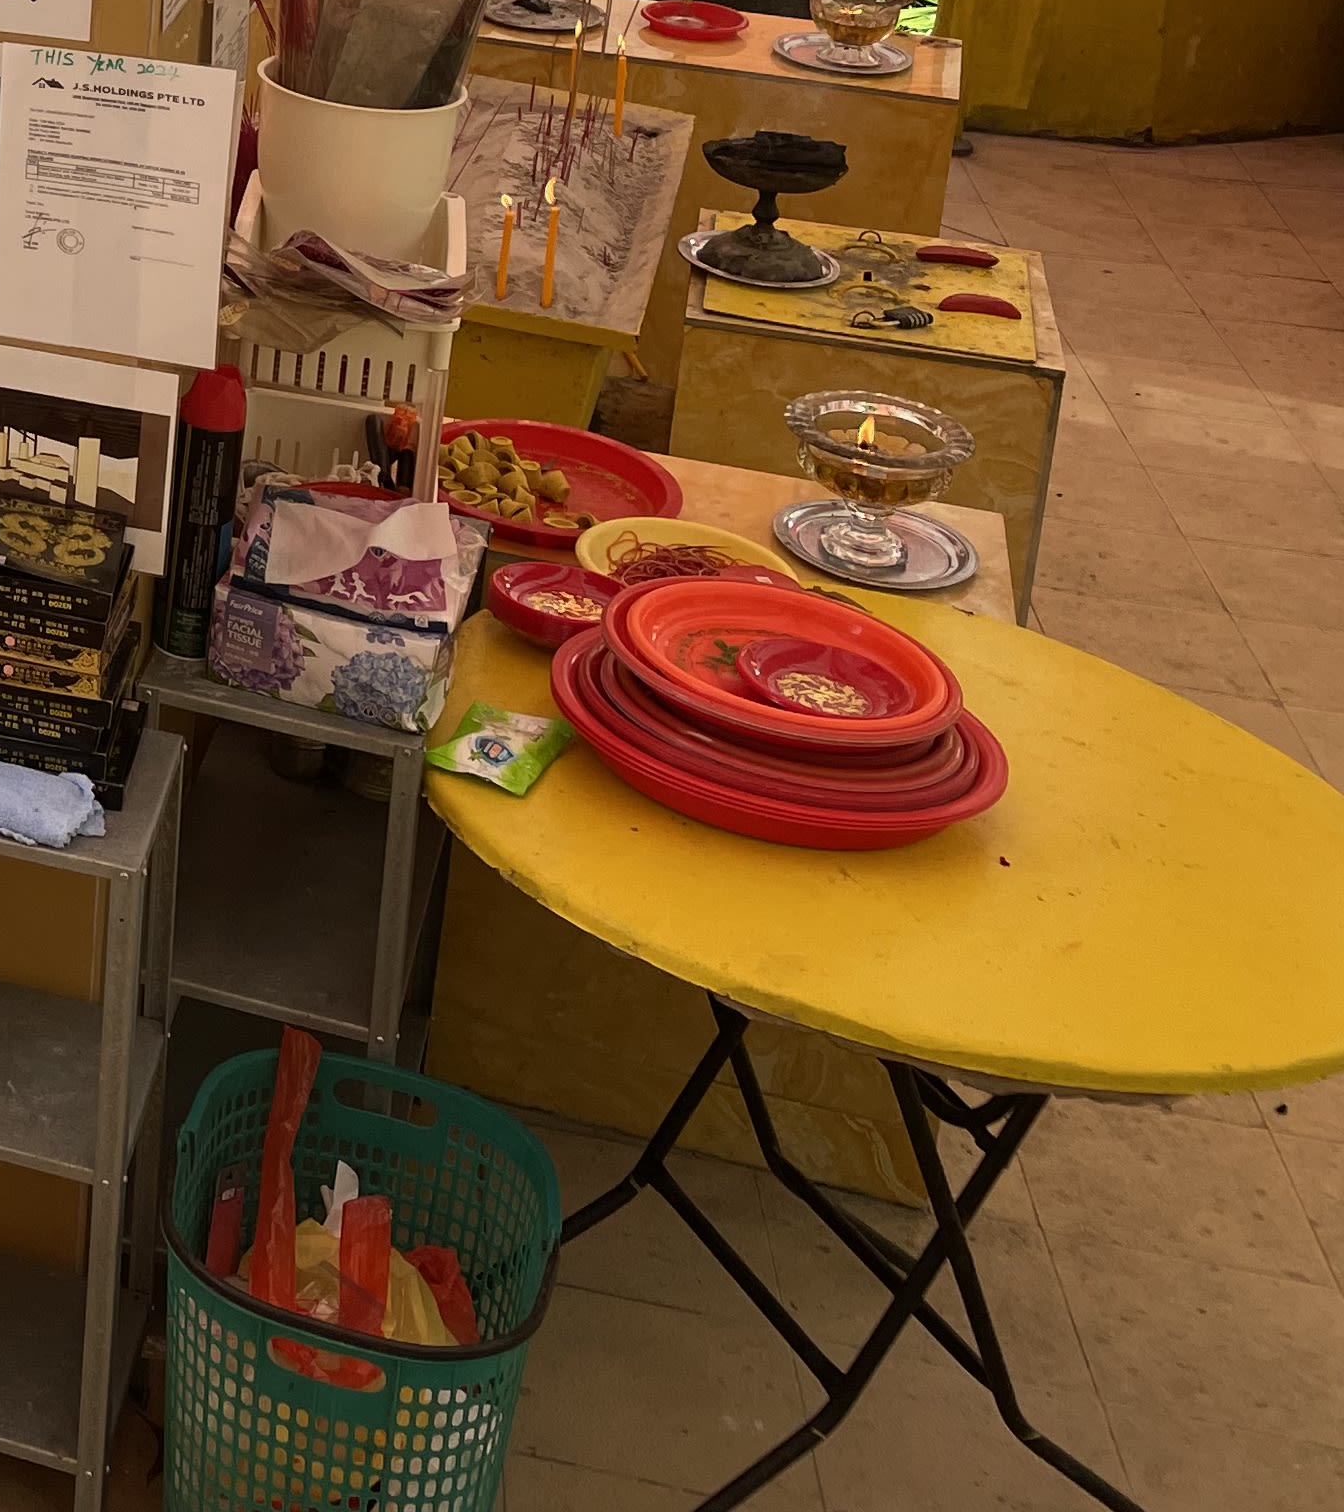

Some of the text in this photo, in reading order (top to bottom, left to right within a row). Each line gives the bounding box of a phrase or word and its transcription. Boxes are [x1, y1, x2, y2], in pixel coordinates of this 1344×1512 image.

[30, 48, 75, 66] THIS
[86, 53, 127, 75] YEAR
[157, 92, 180, 103] PTE
[182, 96, 206, 107] LTD
[48, 600, 73, 611] DOZEN
[229, 599, 264, 616] FairPrice
[45, 627, 69, 638] DOZEN
[227, 622, 264, 640] FACIAL
[227, 629, 262, 648] TISSUE
[49, 708, 73, 719] DOZEN
[38, 727, 61, 739] DOZEN
